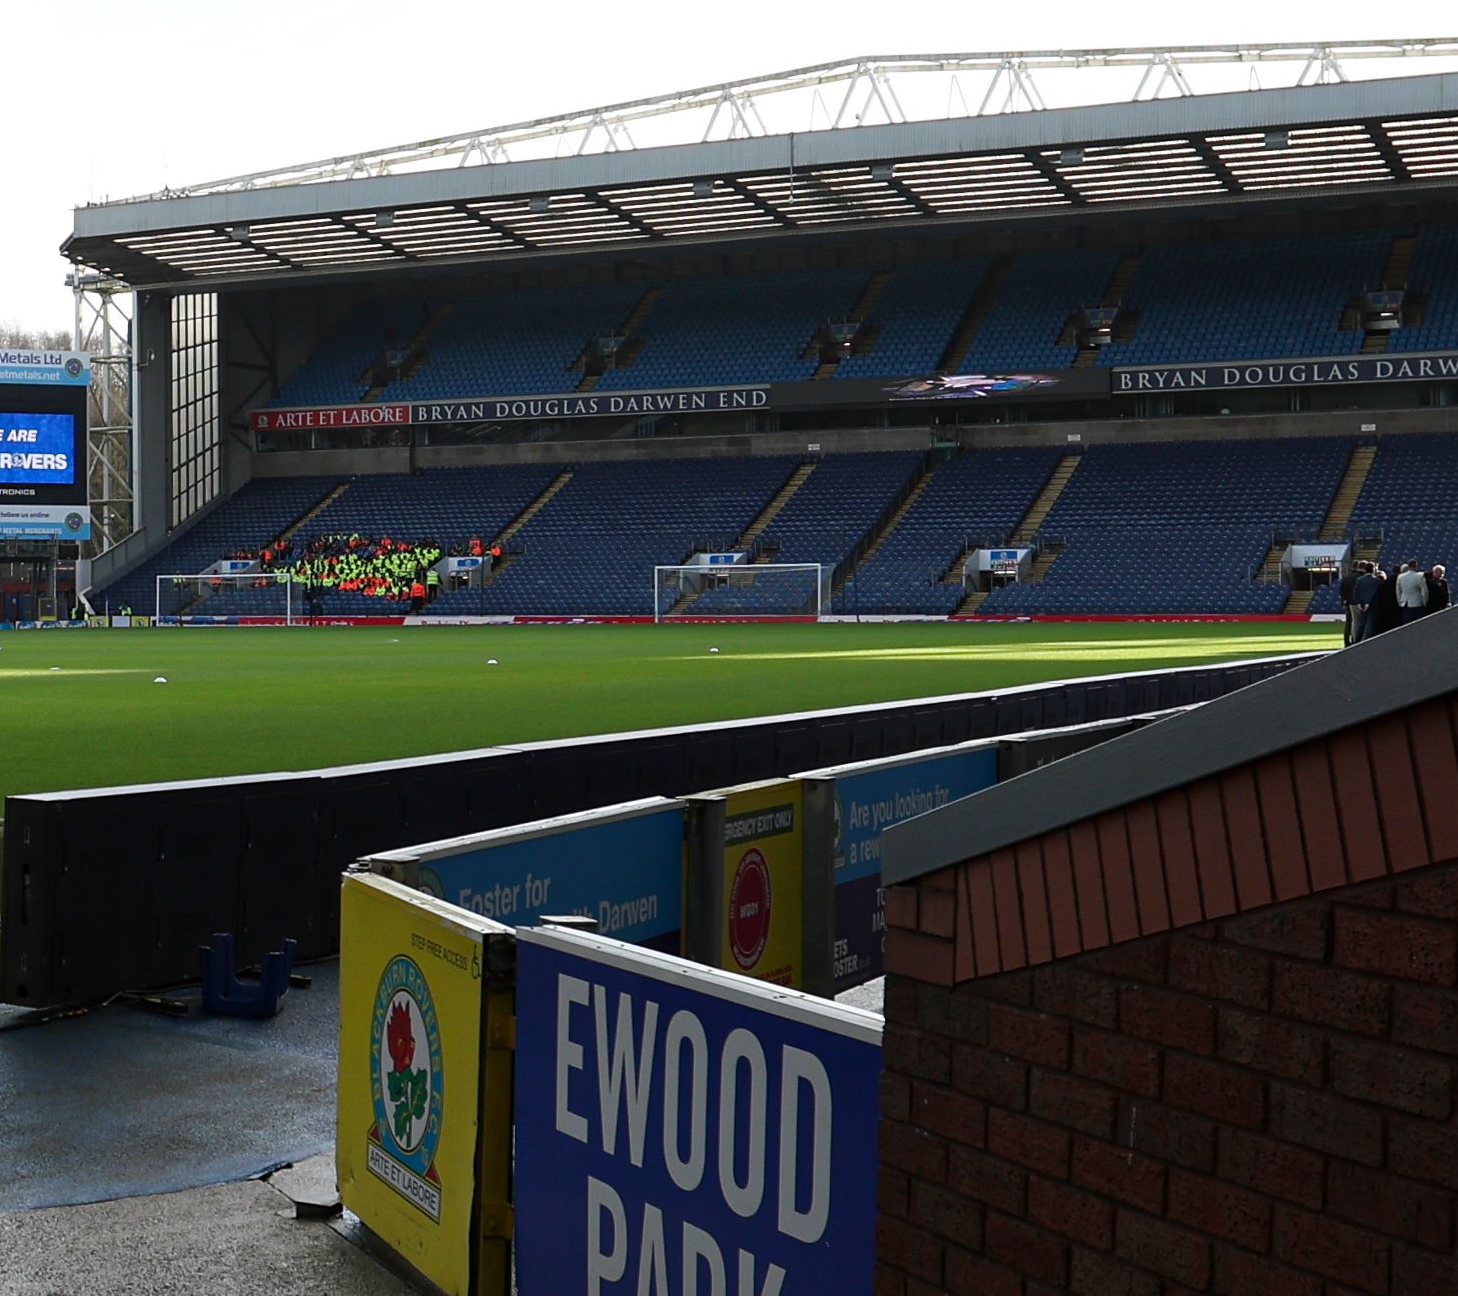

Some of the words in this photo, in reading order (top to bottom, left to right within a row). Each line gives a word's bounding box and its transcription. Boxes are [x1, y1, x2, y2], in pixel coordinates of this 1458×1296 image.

[44, 353, 62, 365] Ltd
[1120, 368, 1207, 389] BRYAN
[1223, 361, 1359, 385] DOUGLAS
[276, 411, 314, 428] ARTE
[319, 410, 337, 425] ET
[342, 406, 403, 424] LABORE
[419, 403, 484, 421] BRYAN
[496, 397, 599, 418] DOUGLAS
[610, 392, 705, 413] DARWEN
[719, 389, 767, 409] END
[7, 429, 38, 443] ARE
[757, 813, 774, 834] EXIT
[775, 808, 794, 829] ONLY
[850, 801, 869, 830] Are
[872, 803, 893, 831] you
[895, 786, 932, 820] looking
[935, 783, 950, 807] for
[850, 842, 858, 864] a
[458, 883, 520, 917] Foster
[525, 873, 552, 909] for
[598, 893, 658, 934] Darwen
[427, 938, 442, 959] FREE
[442, 944, 468, 971] ACCESS
[555, 971, 834, 1245] EWOOD
[370, 1149, 390, 1177] ARTE
[391, 1164, 401, 1186] ET
[402, 1171, 437, 1211] LABORE
